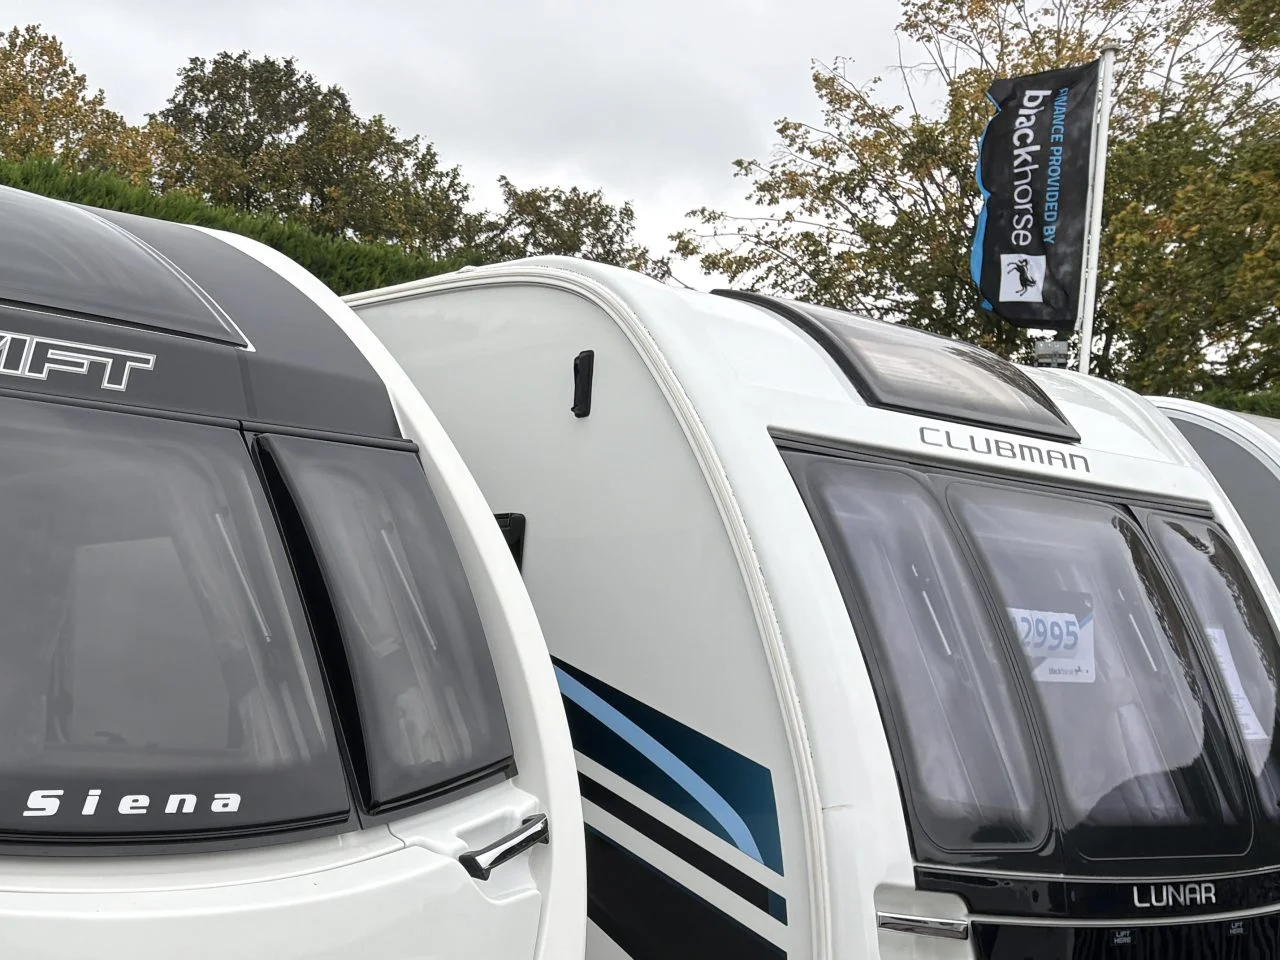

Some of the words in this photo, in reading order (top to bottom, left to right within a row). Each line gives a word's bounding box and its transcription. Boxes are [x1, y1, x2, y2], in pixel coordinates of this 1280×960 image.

[1011, 89, 1053, 246] blackhorse
[1044, 147, 1064, 220] PROVIDED
[1042, 224, 1058, 244] BY
[919, 426, 1090, 473] CLUBMAN
[22, 789, 242, 817] Siena
[1132, 883, 1216, 907] LUNAR
